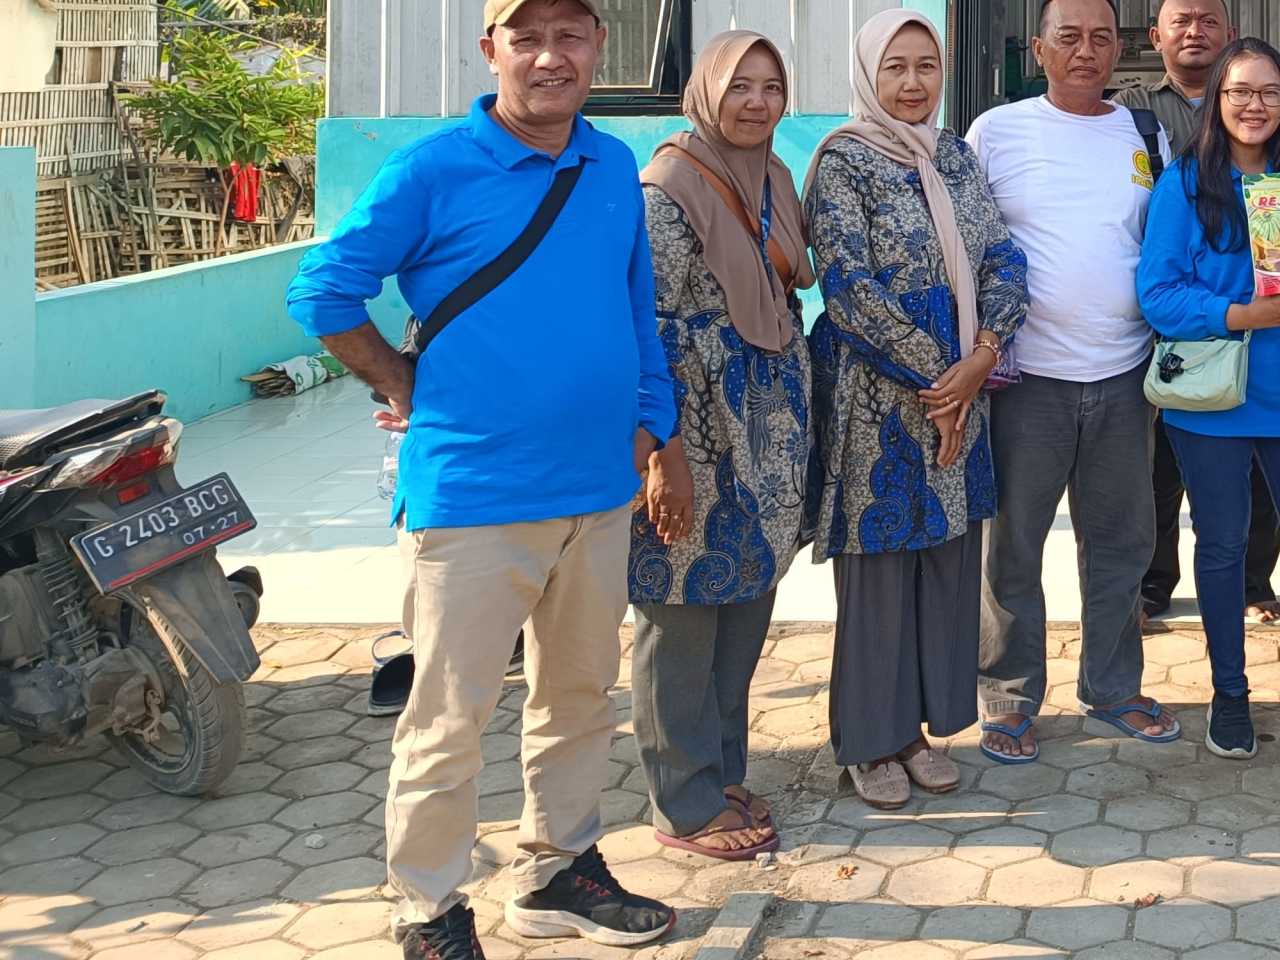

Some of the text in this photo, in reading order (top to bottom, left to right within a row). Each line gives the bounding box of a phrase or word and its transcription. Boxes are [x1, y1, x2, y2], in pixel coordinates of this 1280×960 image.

[93, 484, 229, 558] G 2403 BCG
